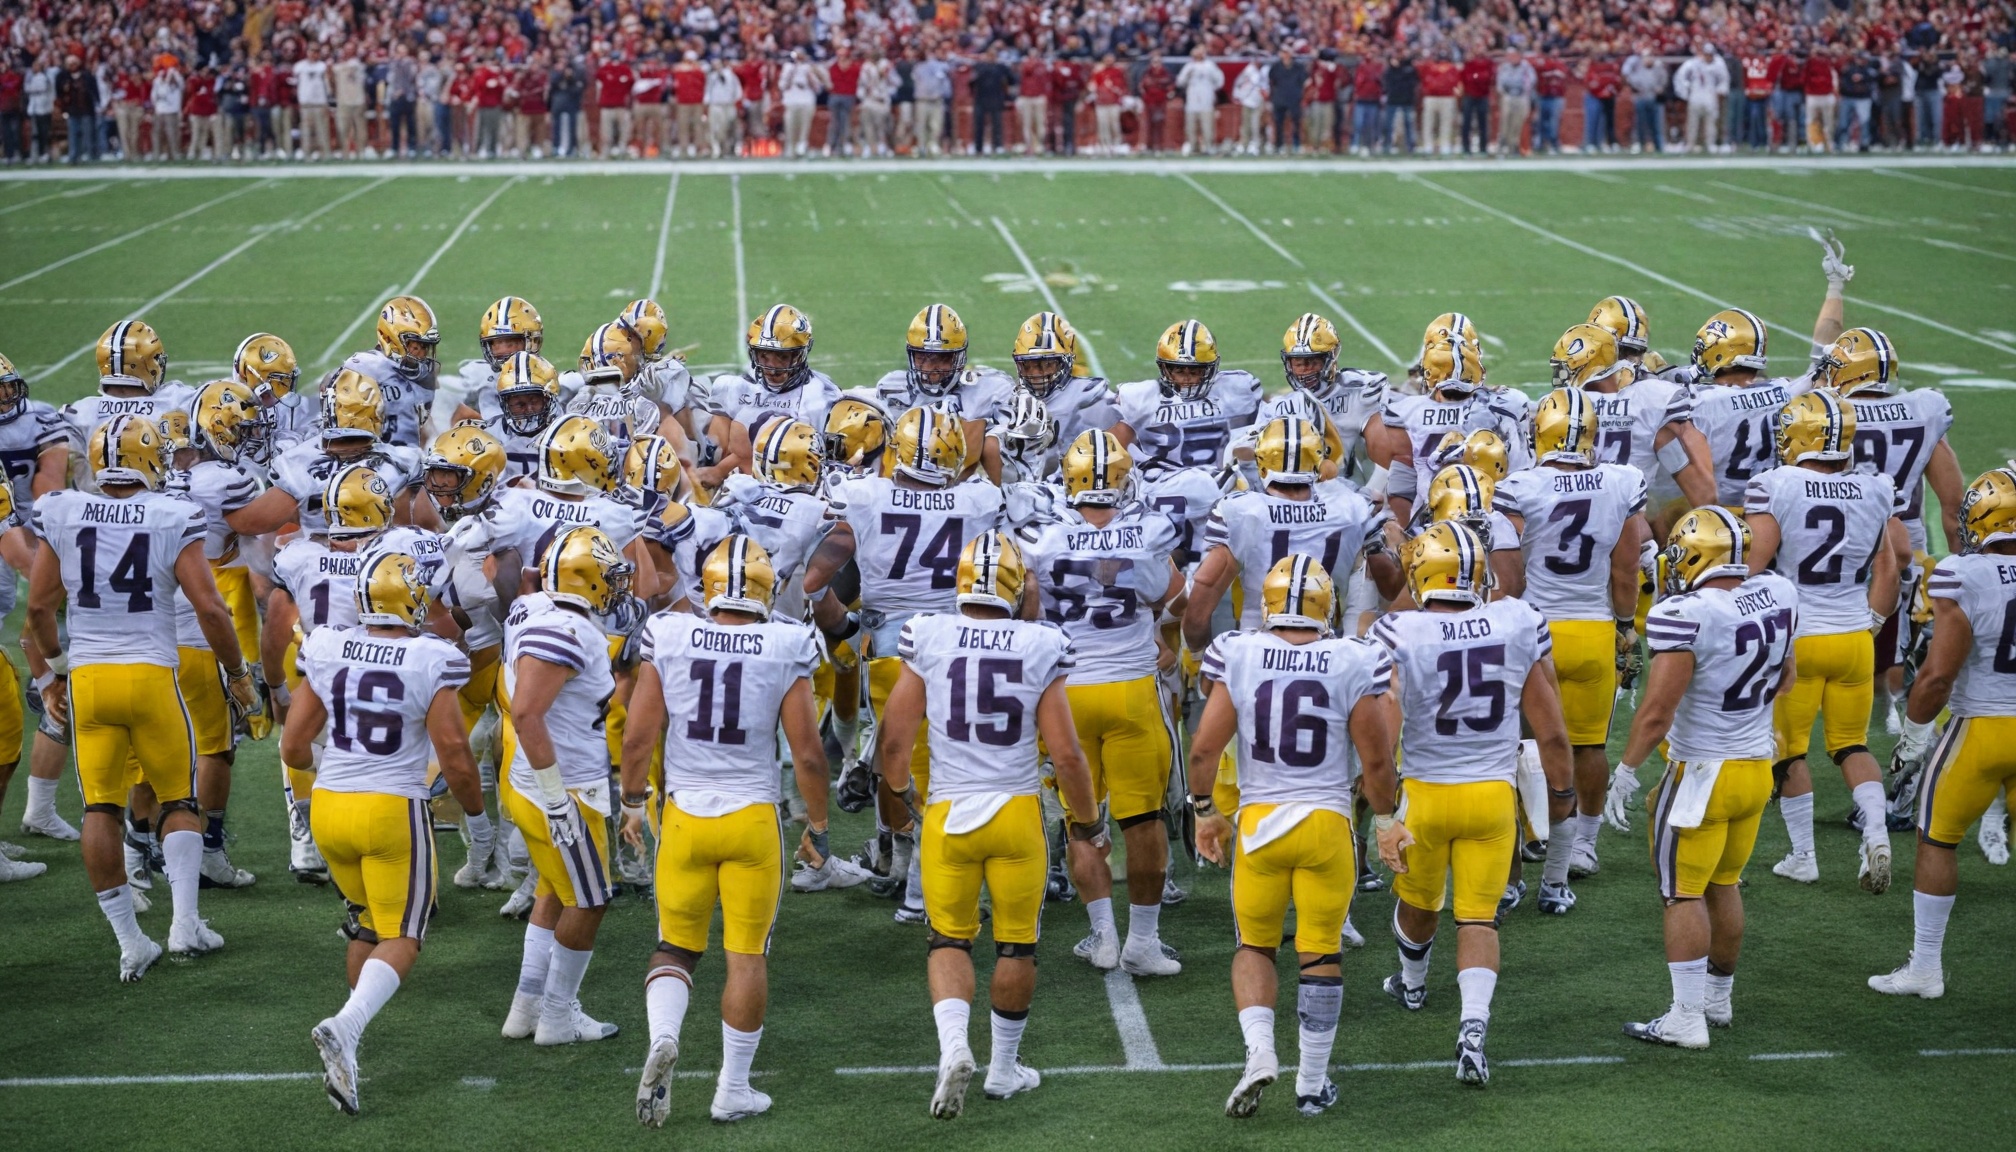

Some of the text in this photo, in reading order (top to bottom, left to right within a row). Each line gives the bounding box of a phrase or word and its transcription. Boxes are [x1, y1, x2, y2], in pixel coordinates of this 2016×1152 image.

[76, 527, 153, 612] 14
[881, 512, 963, 589] 74
[1799, 505, 1845, 584] 2
[687, 660, 746, 745] 11
[947, 656, 1024, 746] 15
[1251, 680, 1330, 768] 16
